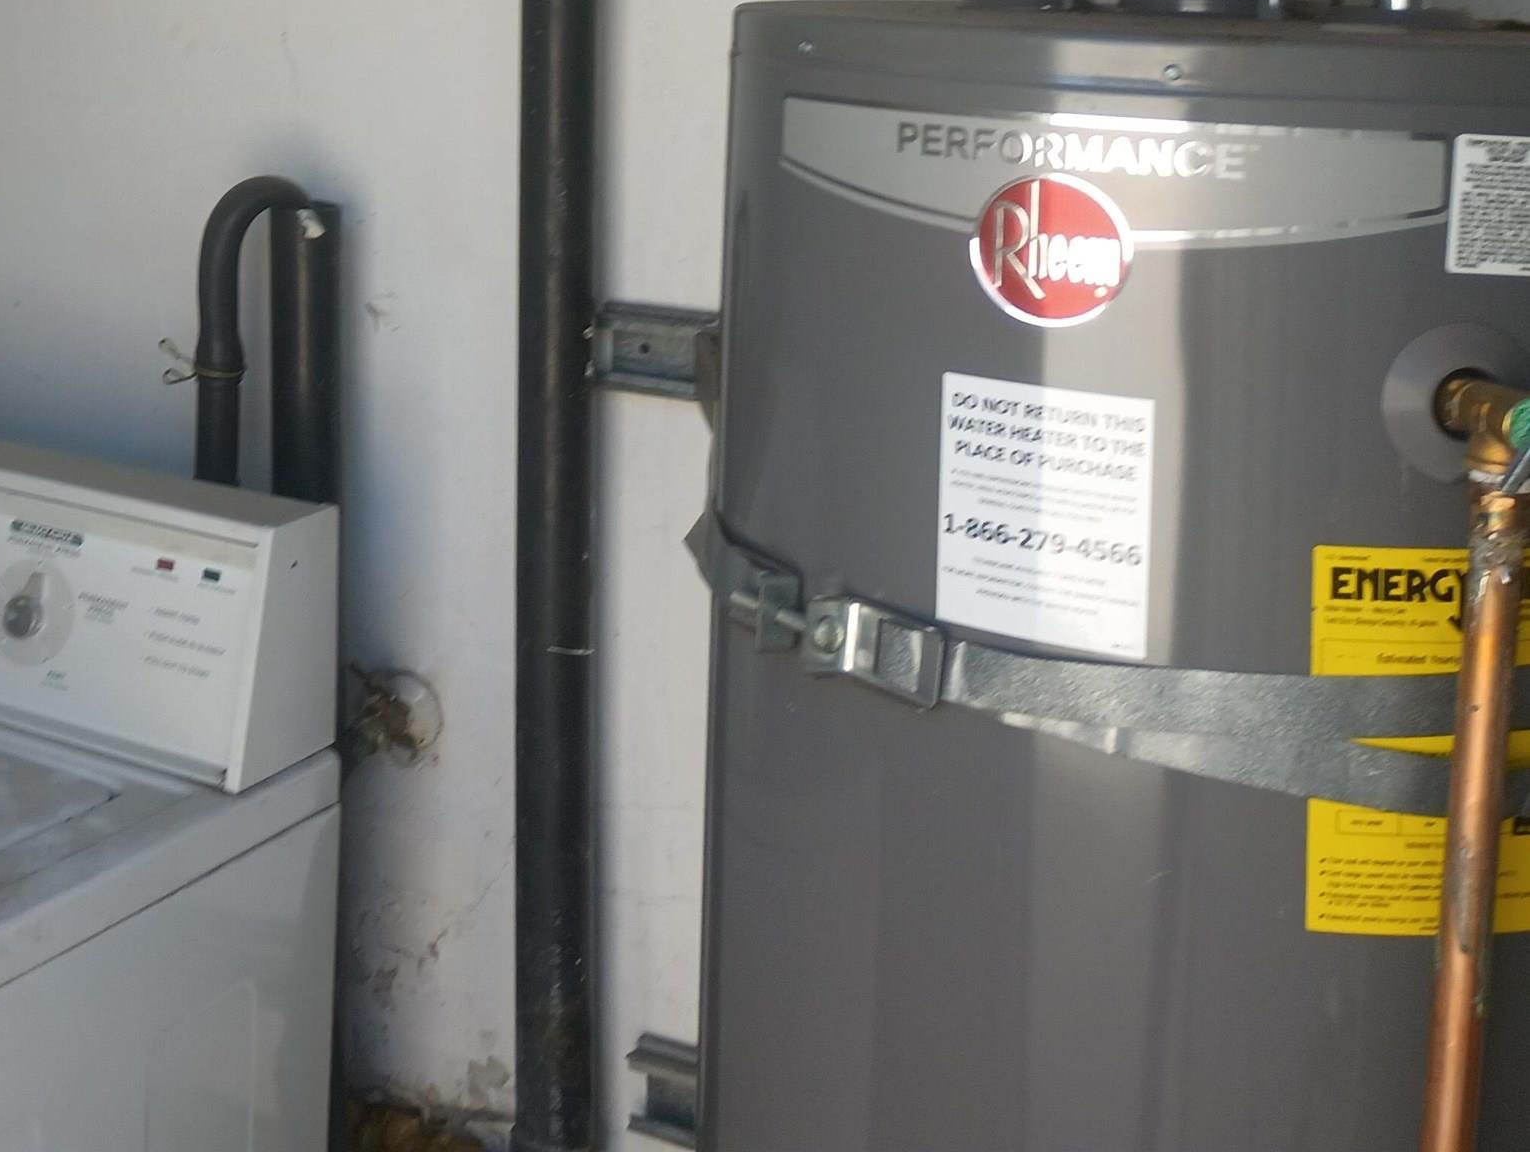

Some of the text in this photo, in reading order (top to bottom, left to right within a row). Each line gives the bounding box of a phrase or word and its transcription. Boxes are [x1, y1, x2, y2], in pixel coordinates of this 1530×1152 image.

[897, 121, 1247, 179] PERFORMANCE
[991, 179, 1121, 300] Rheem
[948, 414, 1146, 457] WATER HEATER TO THE
[952, 392, 1146, 433] DO NOT RETURN THIS
[954, 440, 1138, 481] PLACE OF PURCHASE
[943, 513, 1142, 566] 1-866-279-4566
